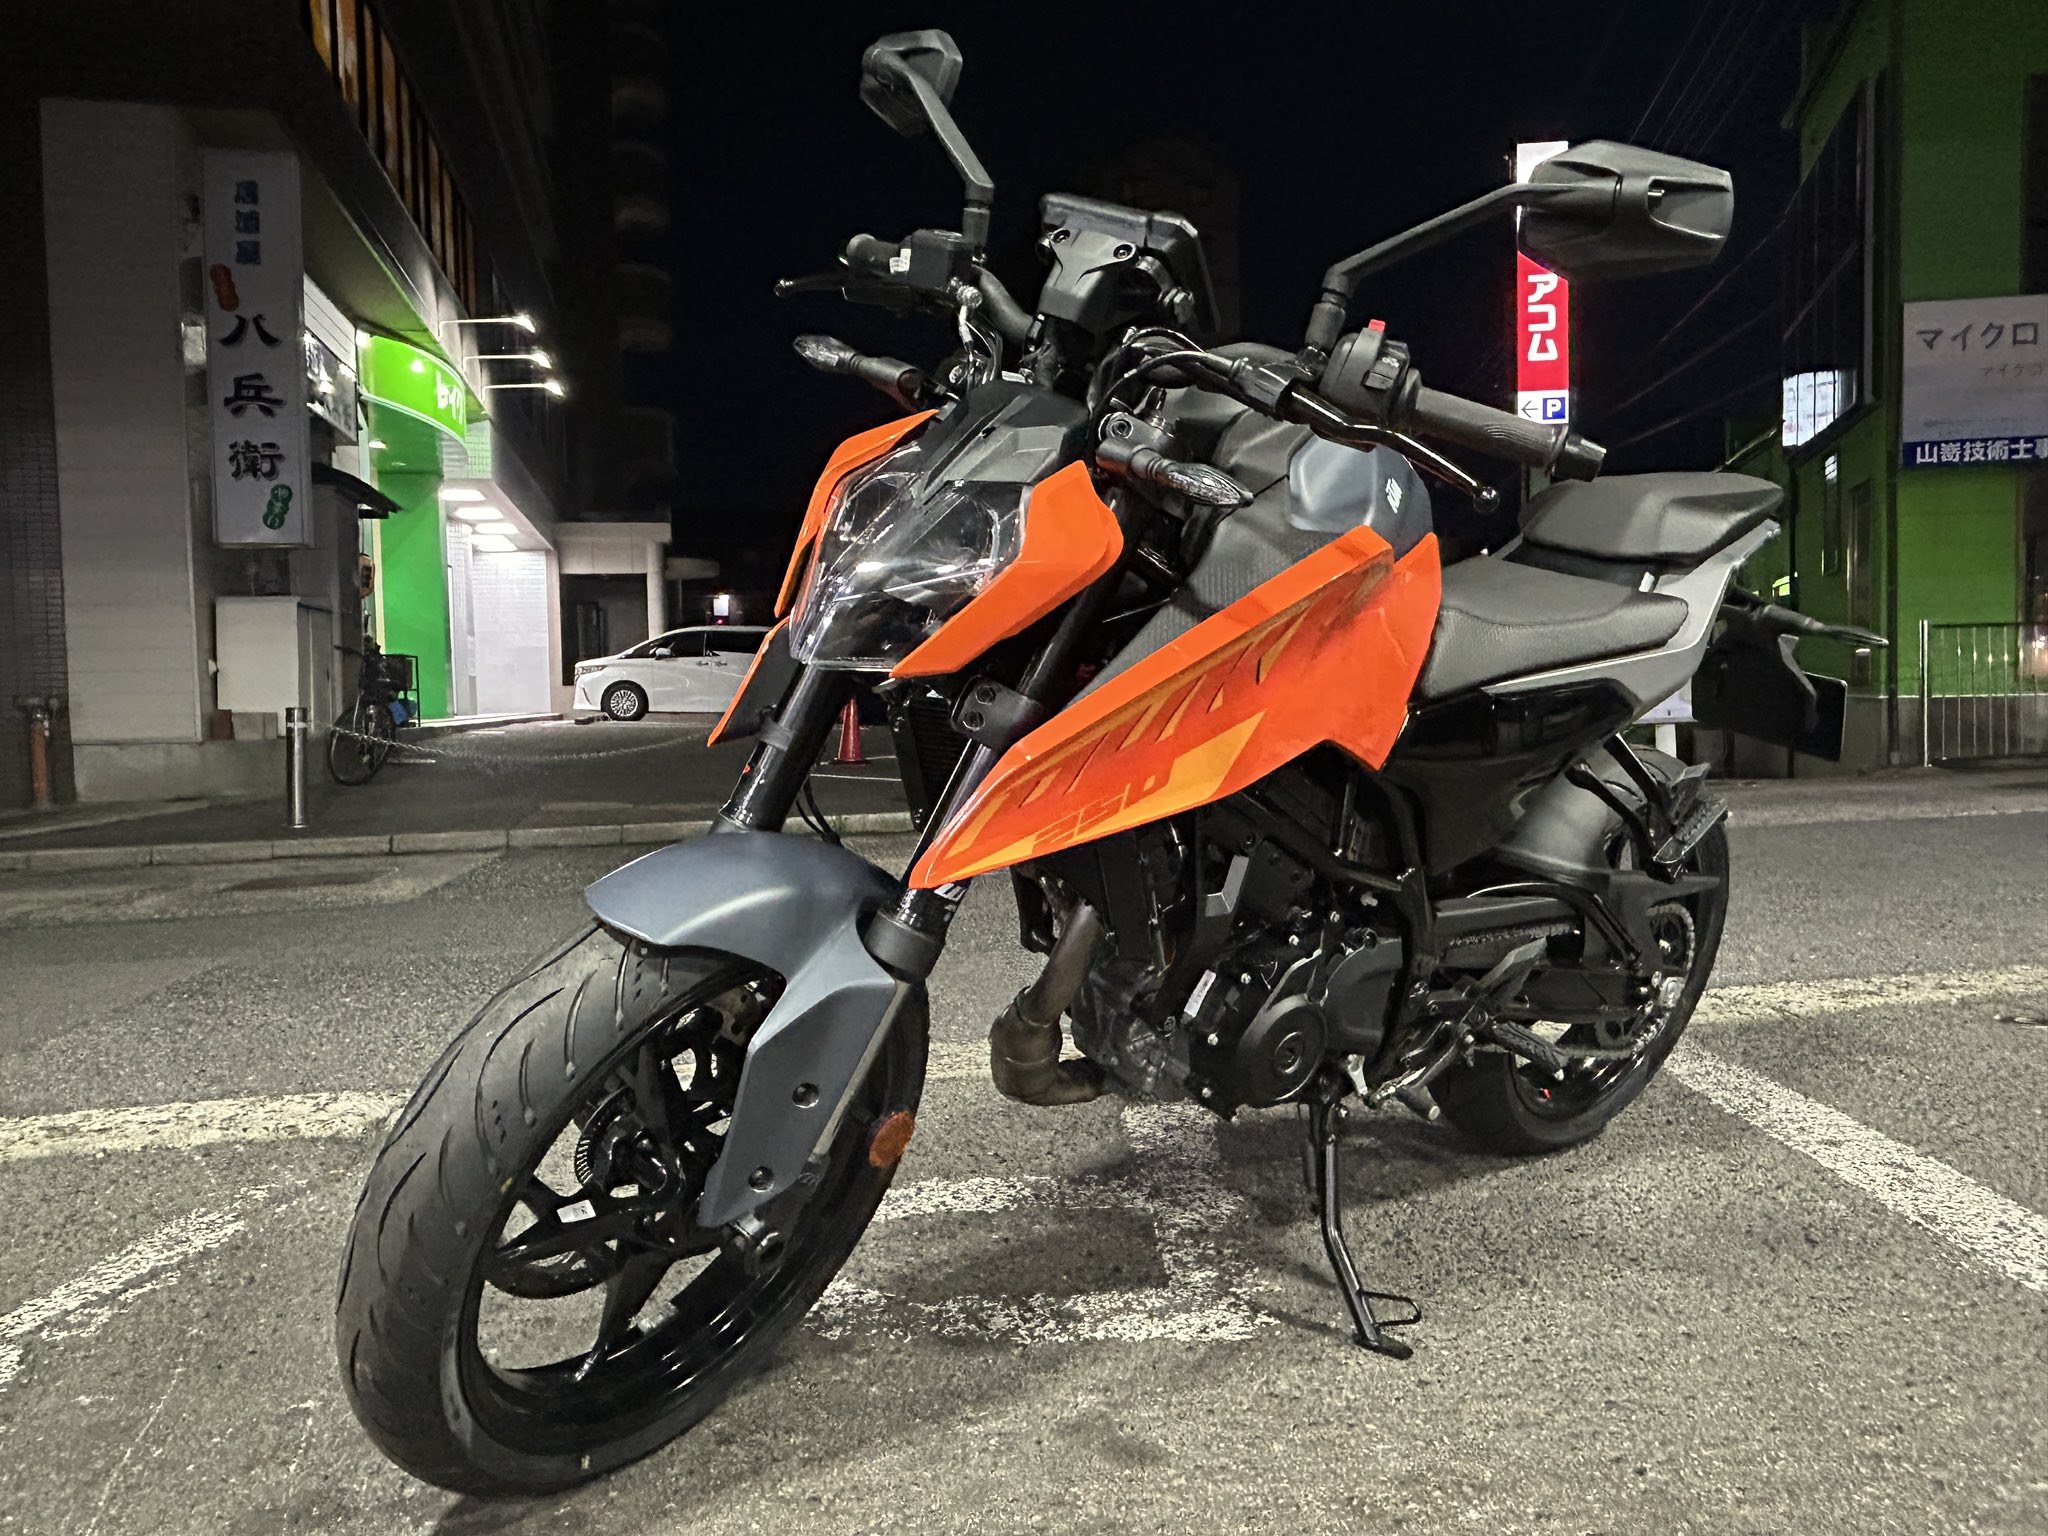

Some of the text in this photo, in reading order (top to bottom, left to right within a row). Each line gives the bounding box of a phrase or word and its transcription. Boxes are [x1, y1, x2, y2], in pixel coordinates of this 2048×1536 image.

[1527, 273, 1558, 361] アコム
[1915, 322, 2038, 351] マイクロ
[218, 313, 286, 481] 八兵衛
[1546, 399, 1561, 418] P
